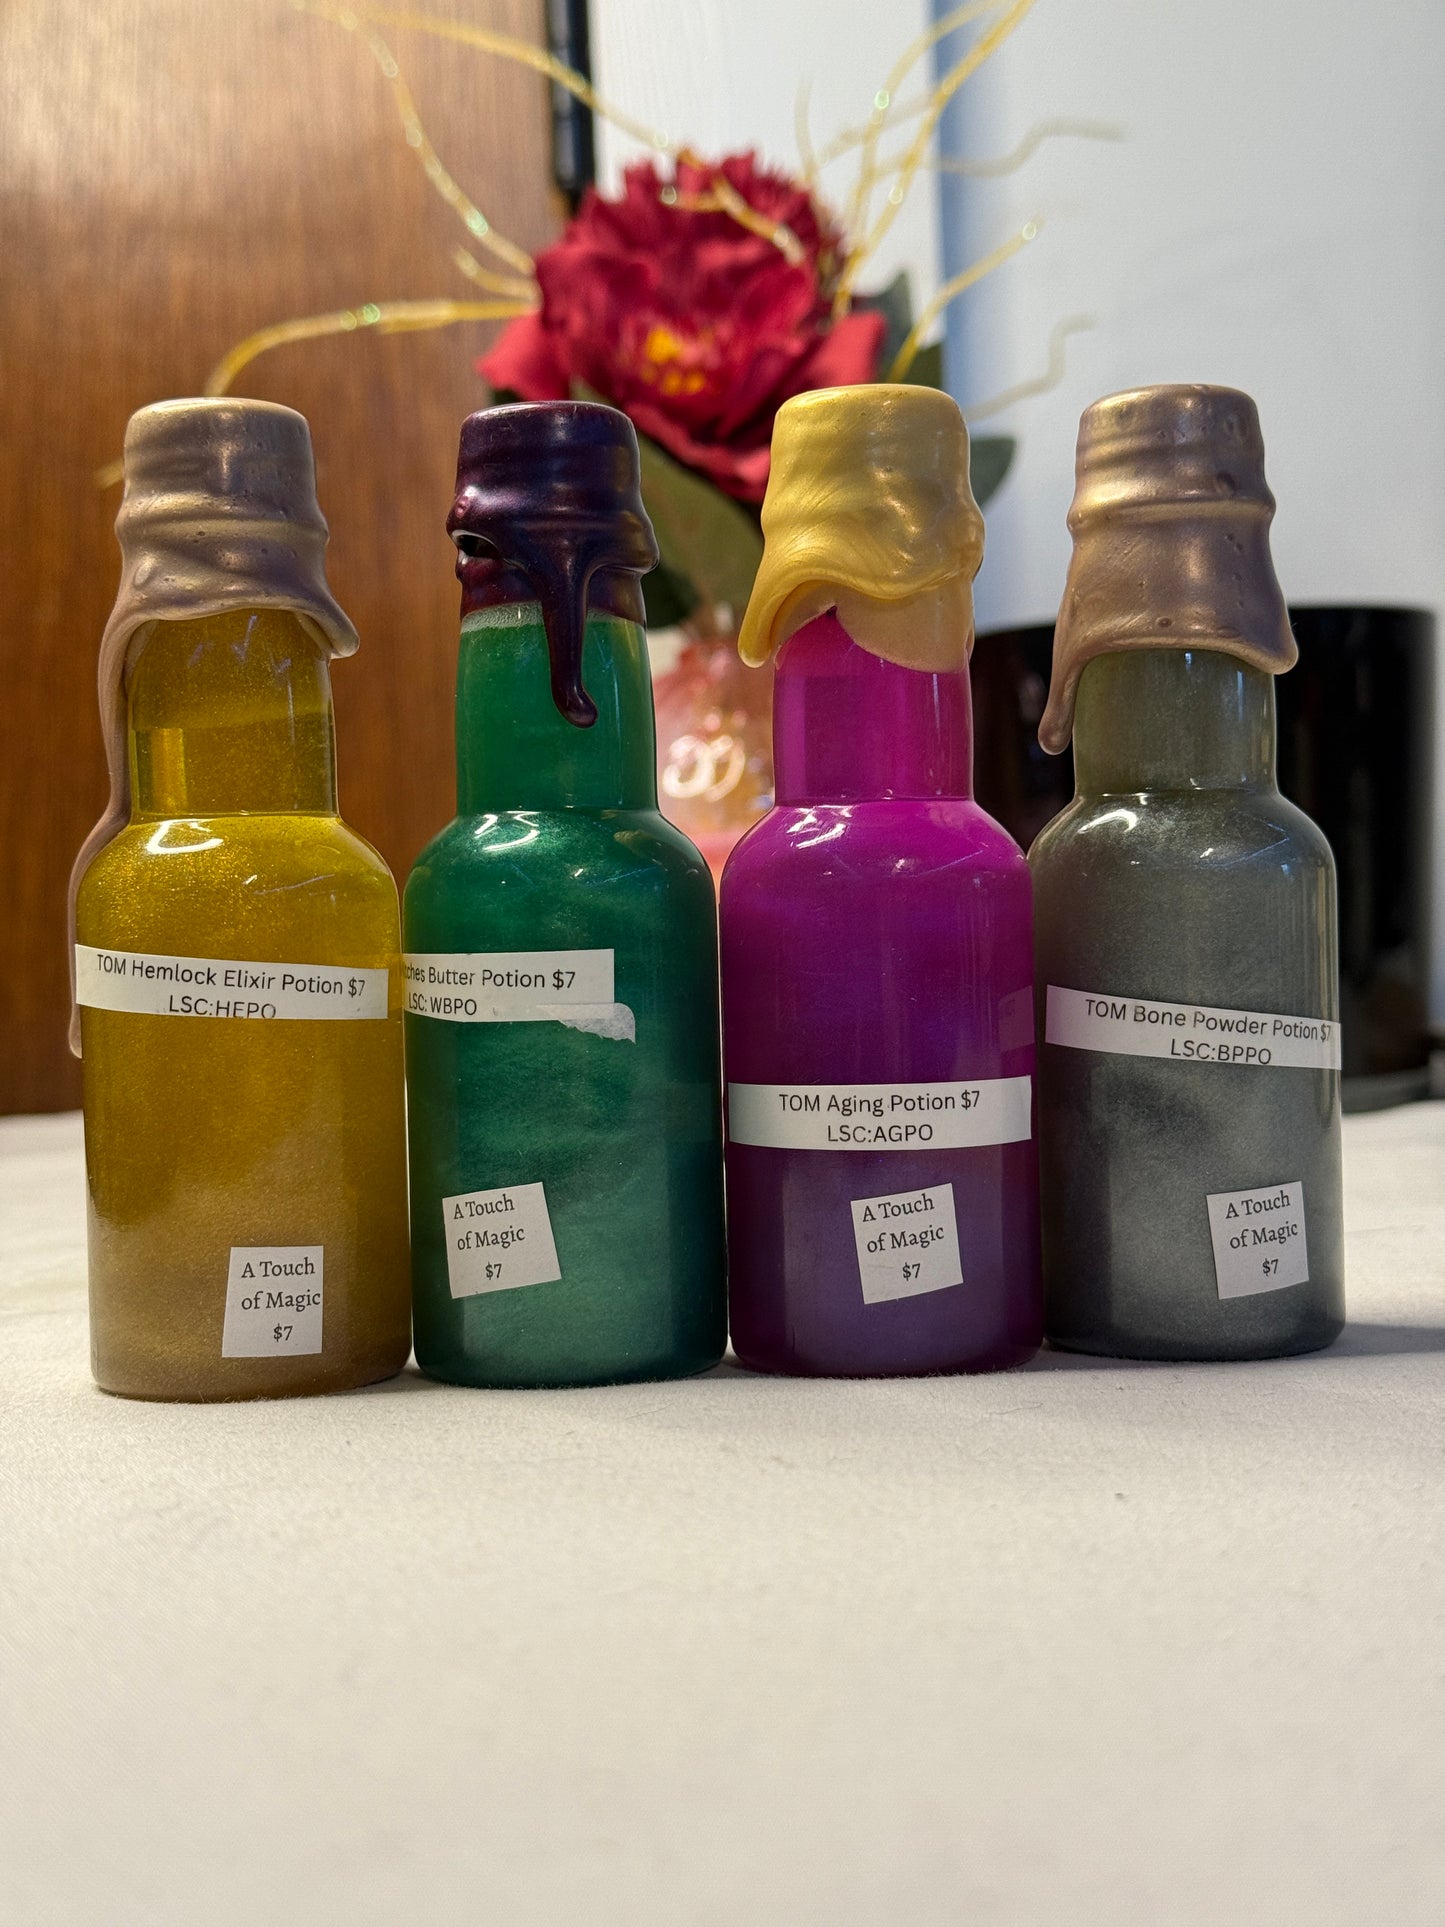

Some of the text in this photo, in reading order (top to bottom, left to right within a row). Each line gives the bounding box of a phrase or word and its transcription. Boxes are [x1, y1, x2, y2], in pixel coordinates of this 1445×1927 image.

[97, 954, 366, 997] TOM Hemlock Elixir Potion $7
[428, 966, 476, 986] Butter
[482, 969, 545, 988] Potion
[552, 969, 576, 990] $7
[408, 992, 477, 1016] LSC: WBPO
[1086, 999, 1332, 1043] TOM Bone Powder Potion $7
[1170, 1038, 1272, 1065] LSC:BPPO
[778, 1090, 981, 1117] TOM Aging Potion $7
[827, 1124, 933, 1143] LSC:AGPO
[453, 1193, 515, 1219] A Touch
[862, 1193, 935, 1222] A Touch
[1225, 1190, 1291, 1219] A Touch
[457, 1225, 526, 1250] of Magic
[867, 1224, 945, 1253] of Magic
[1229, 1221, 1298, 1249] of Magic
[241, 1256, 315, 1278] A Touch
[485, 1261, 502, 1280] $7
[902, 1262, 921, 1281] $7
[1262, 1258, 1279, 1276] $7
[241, 1289, 321, 1312] of Magic
[273, 1323, 293, 1342] $7
